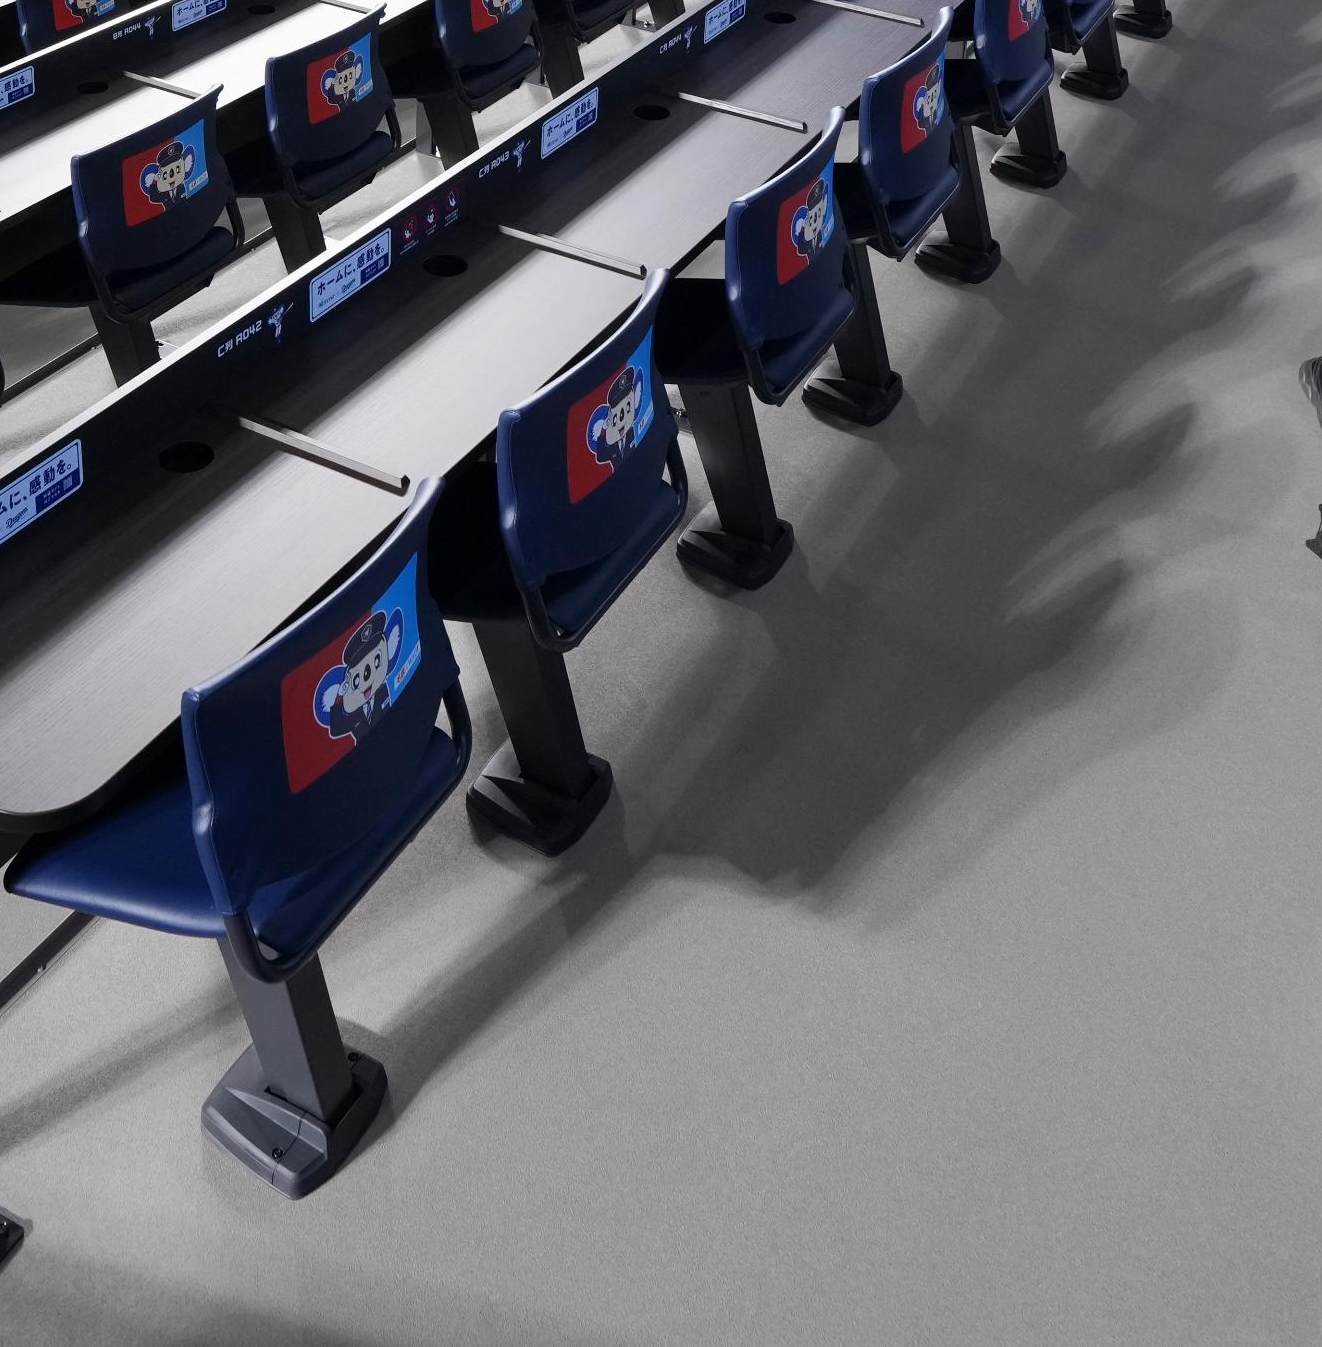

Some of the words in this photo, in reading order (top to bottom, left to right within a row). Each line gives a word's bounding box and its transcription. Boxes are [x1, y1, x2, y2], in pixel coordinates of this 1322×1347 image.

[124, 22, 141, 36] R044
[491, 151, 510, 171] R043
[317, 242, 385, 296] ホームに、感動を。
[217, 338, 233, 358] C列
[235, 319, 262, 346] R042
